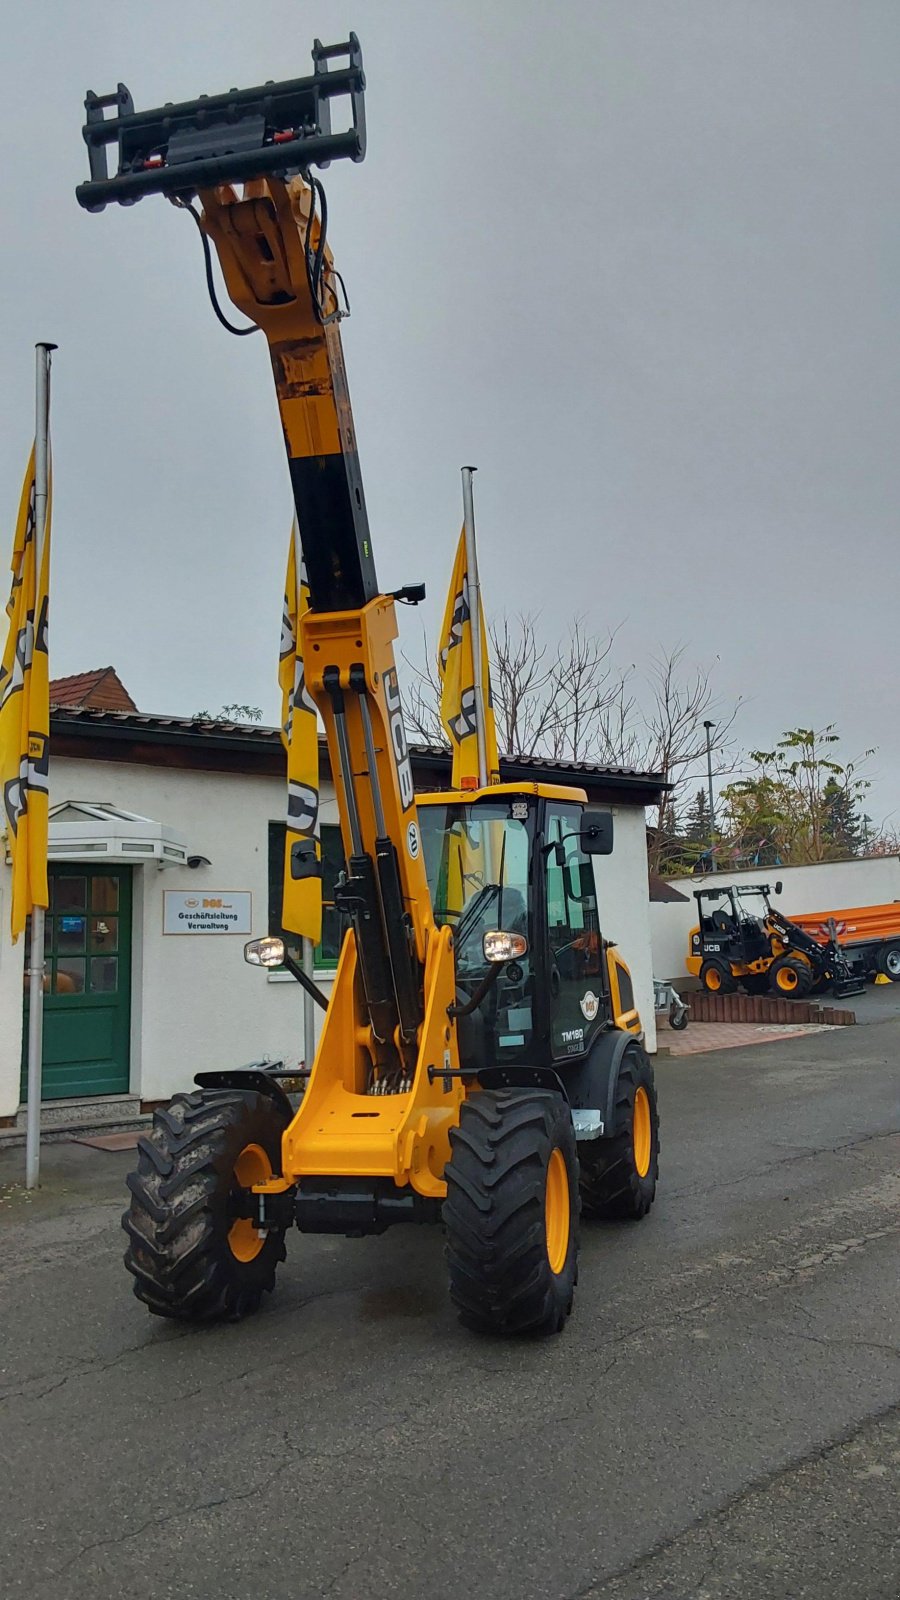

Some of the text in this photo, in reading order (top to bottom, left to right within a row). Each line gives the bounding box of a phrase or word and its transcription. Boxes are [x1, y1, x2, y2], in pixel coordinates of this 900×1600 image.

[383, 672, 414, 809] JCB
[409, 826, 418, 853] 20
[178, 912, 238, 921] Geschäftsleitung
[187, 922, 229, 931] Verwaltung
[773, 923, 786, 934] JCB
[703, 944, 721, 952] JCB
